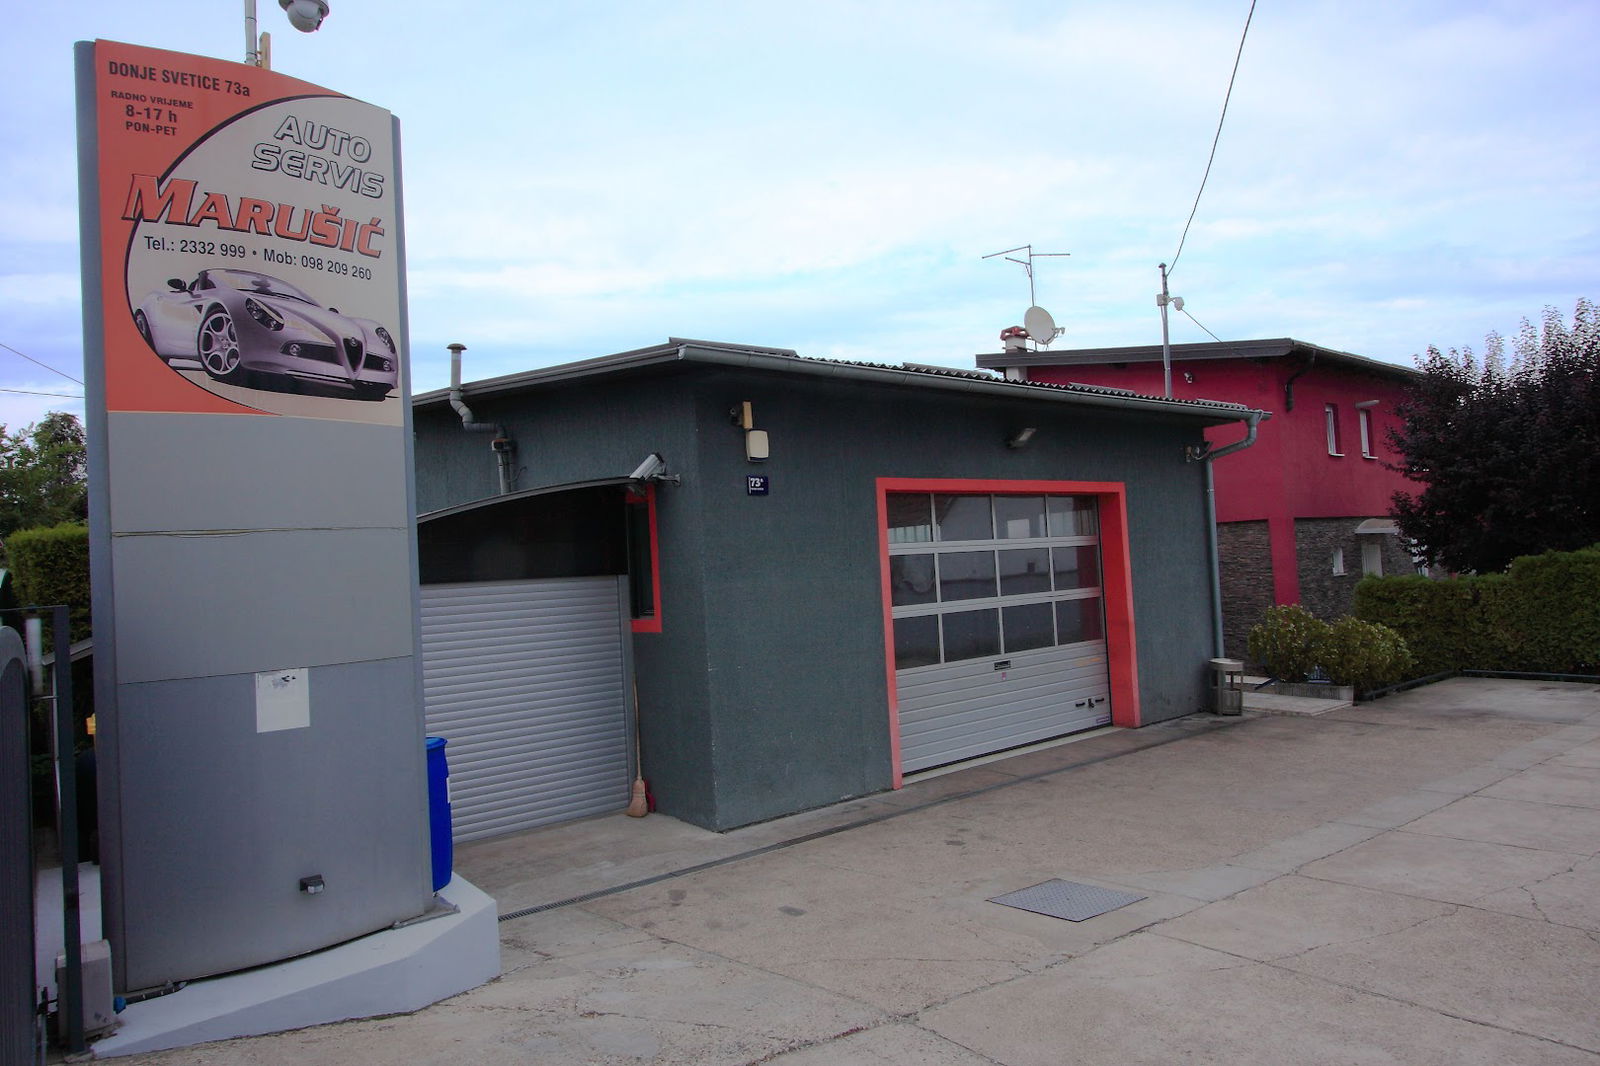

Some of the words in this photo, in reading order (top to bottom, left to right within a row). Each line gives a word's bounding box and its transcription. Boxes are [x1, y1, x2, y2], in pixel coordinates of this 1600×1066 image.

[109, 61, 156, 80] DONJE
[162, 69, 220, 91] SVETICE
[225, 80, 250, 97] 73a
[111, 90, 147, 103] RADNO
[150, 96, 193, 109] VRIJEME
[126, 104, 162, 120] 8-17
[169, 110, 177, 123] h
[126, 121, 177, 136] PON-PET
[274, 115, 371, 164] AUTO
[251, 143, 384, 199] SERVIS
[121, 173, 385, 258] MARUŠIĆ
[144, 235, 175, 251] Tel.:
[180, 240, 215, 255] 2332
[220, 243, 246, 258] 999
[264, 248, 297, 265] Mob:
[301, 255, 323, 271] 098
[327, 260, 348, 275] 209
[351, 265, 372, 280] 260
